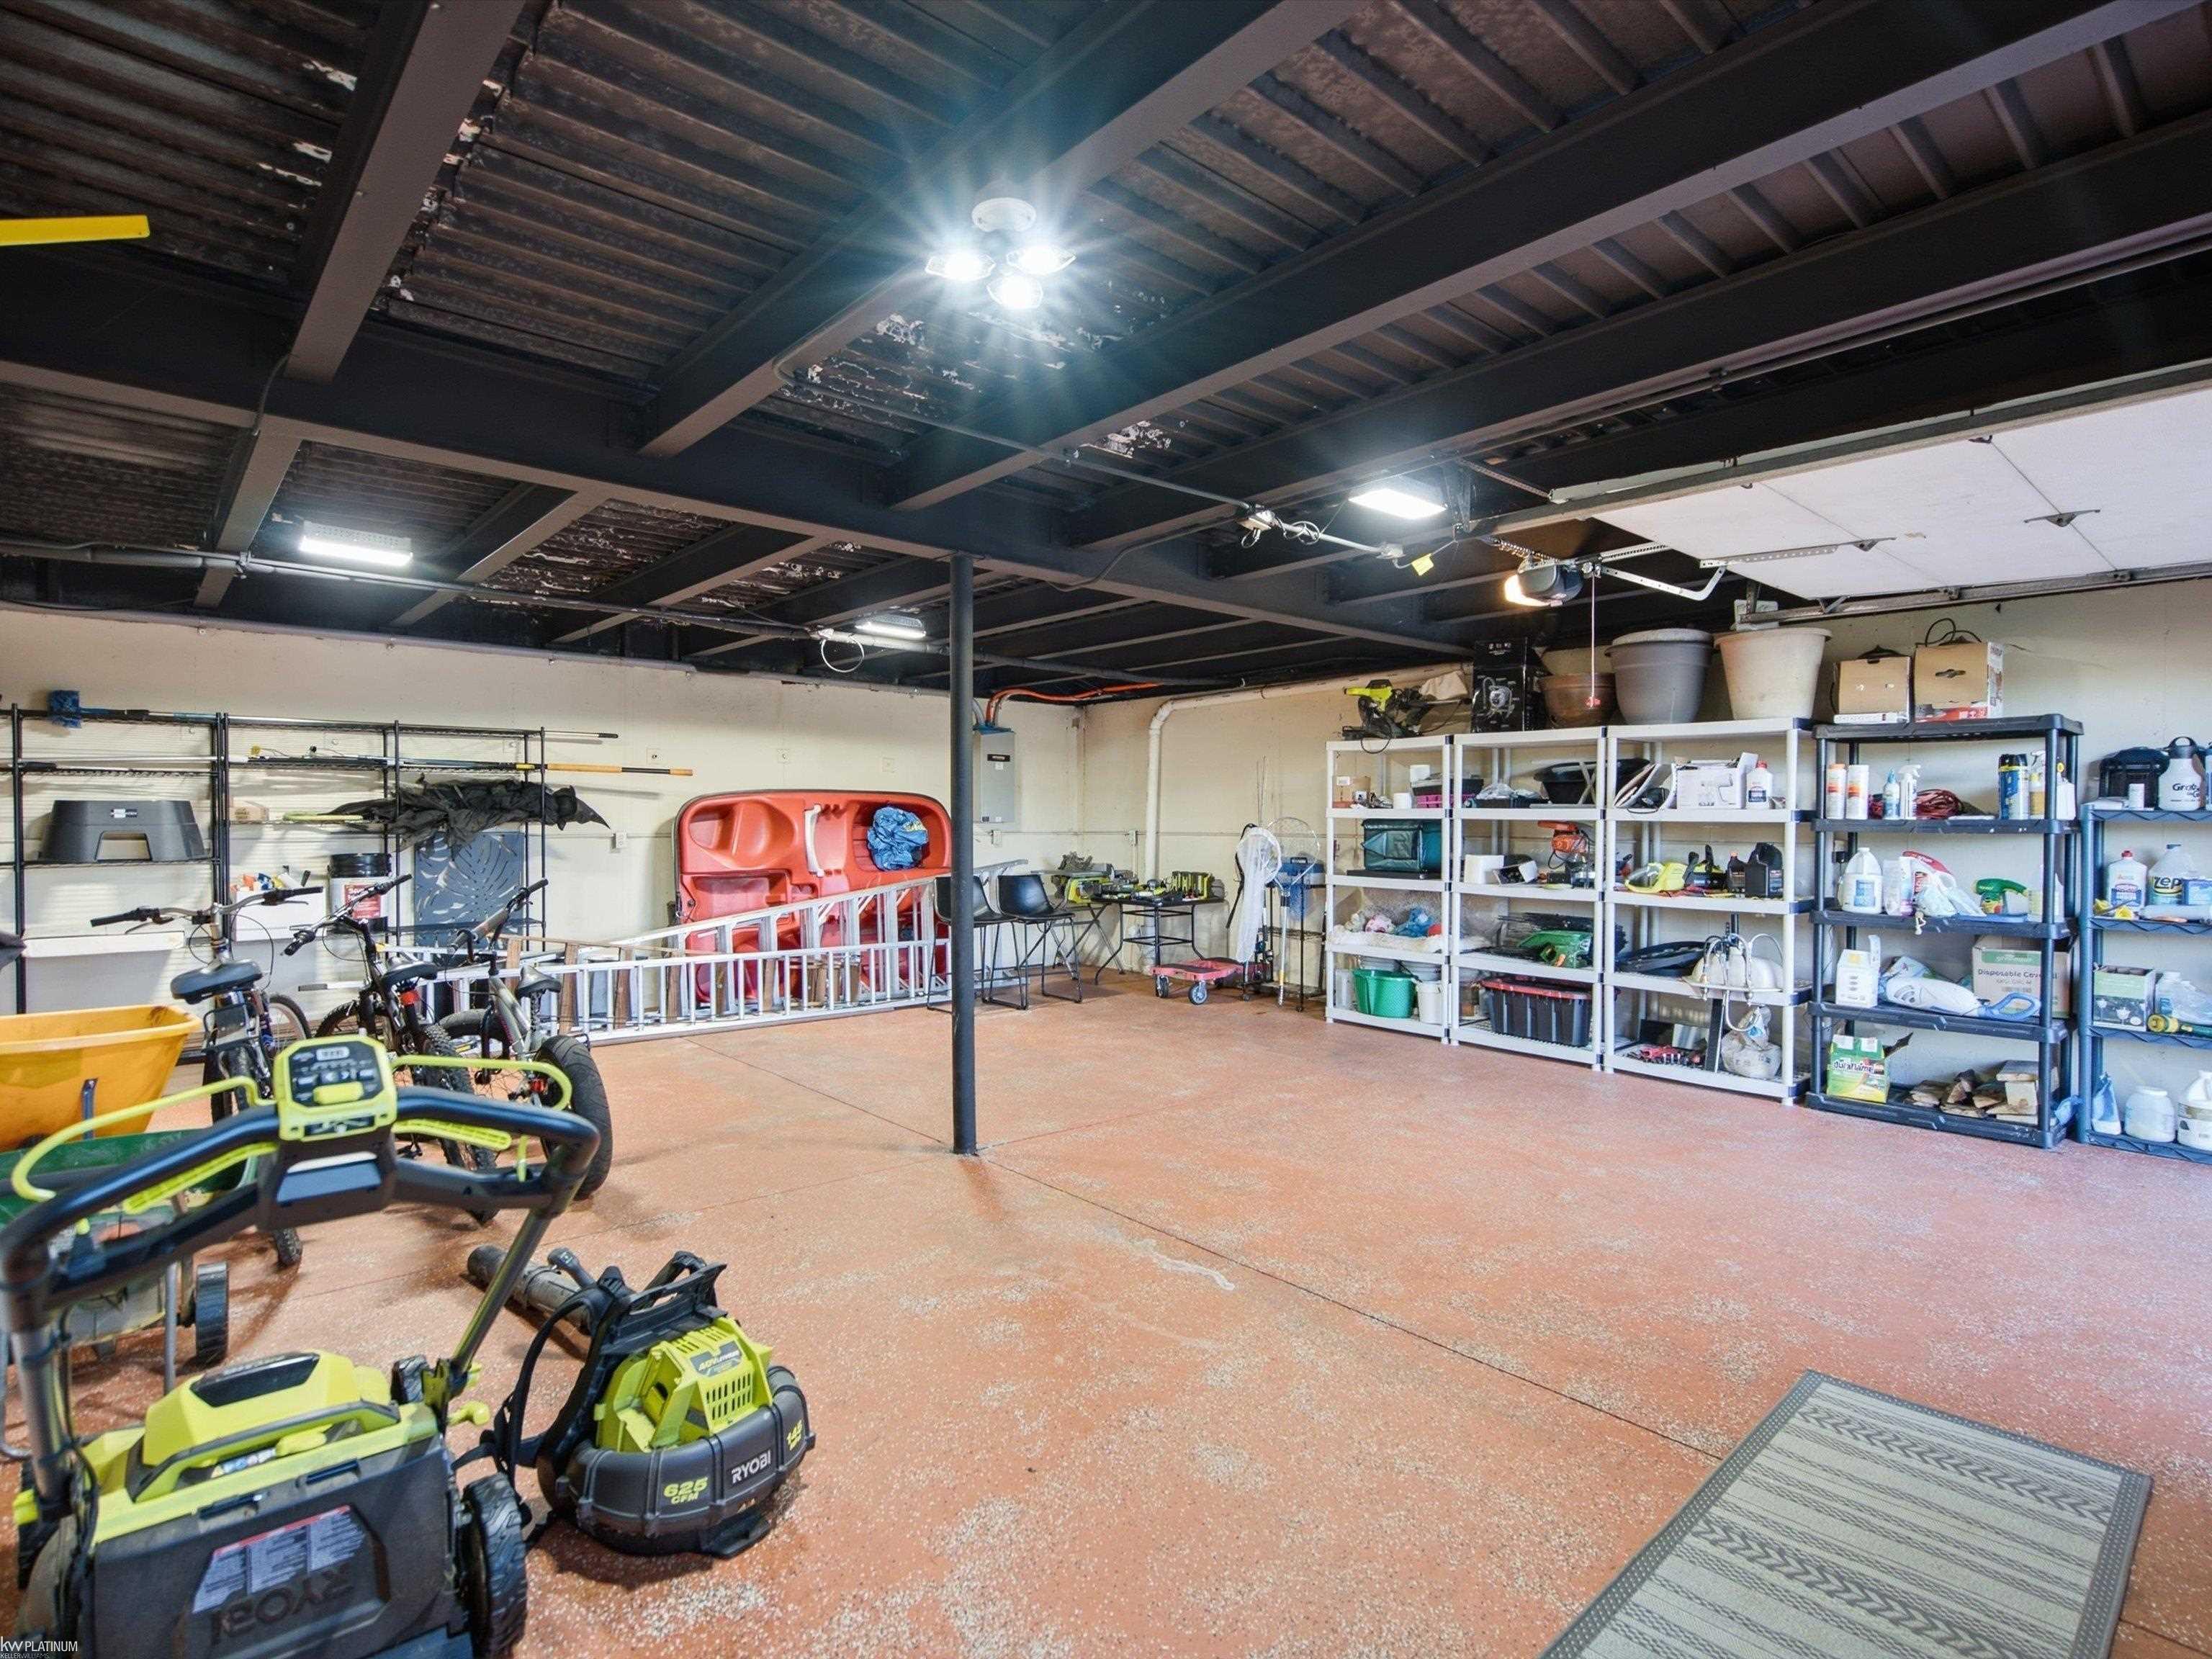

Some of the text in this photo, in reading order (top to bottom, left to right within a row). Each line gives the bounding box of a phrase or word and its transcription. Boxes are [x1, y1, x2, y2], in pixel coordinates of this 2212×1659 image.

[731, 1450, 771, 1484] RYOBI
[663, 1476, 708, 1498] 625
[670, 1491, 699, 1506] CFM
